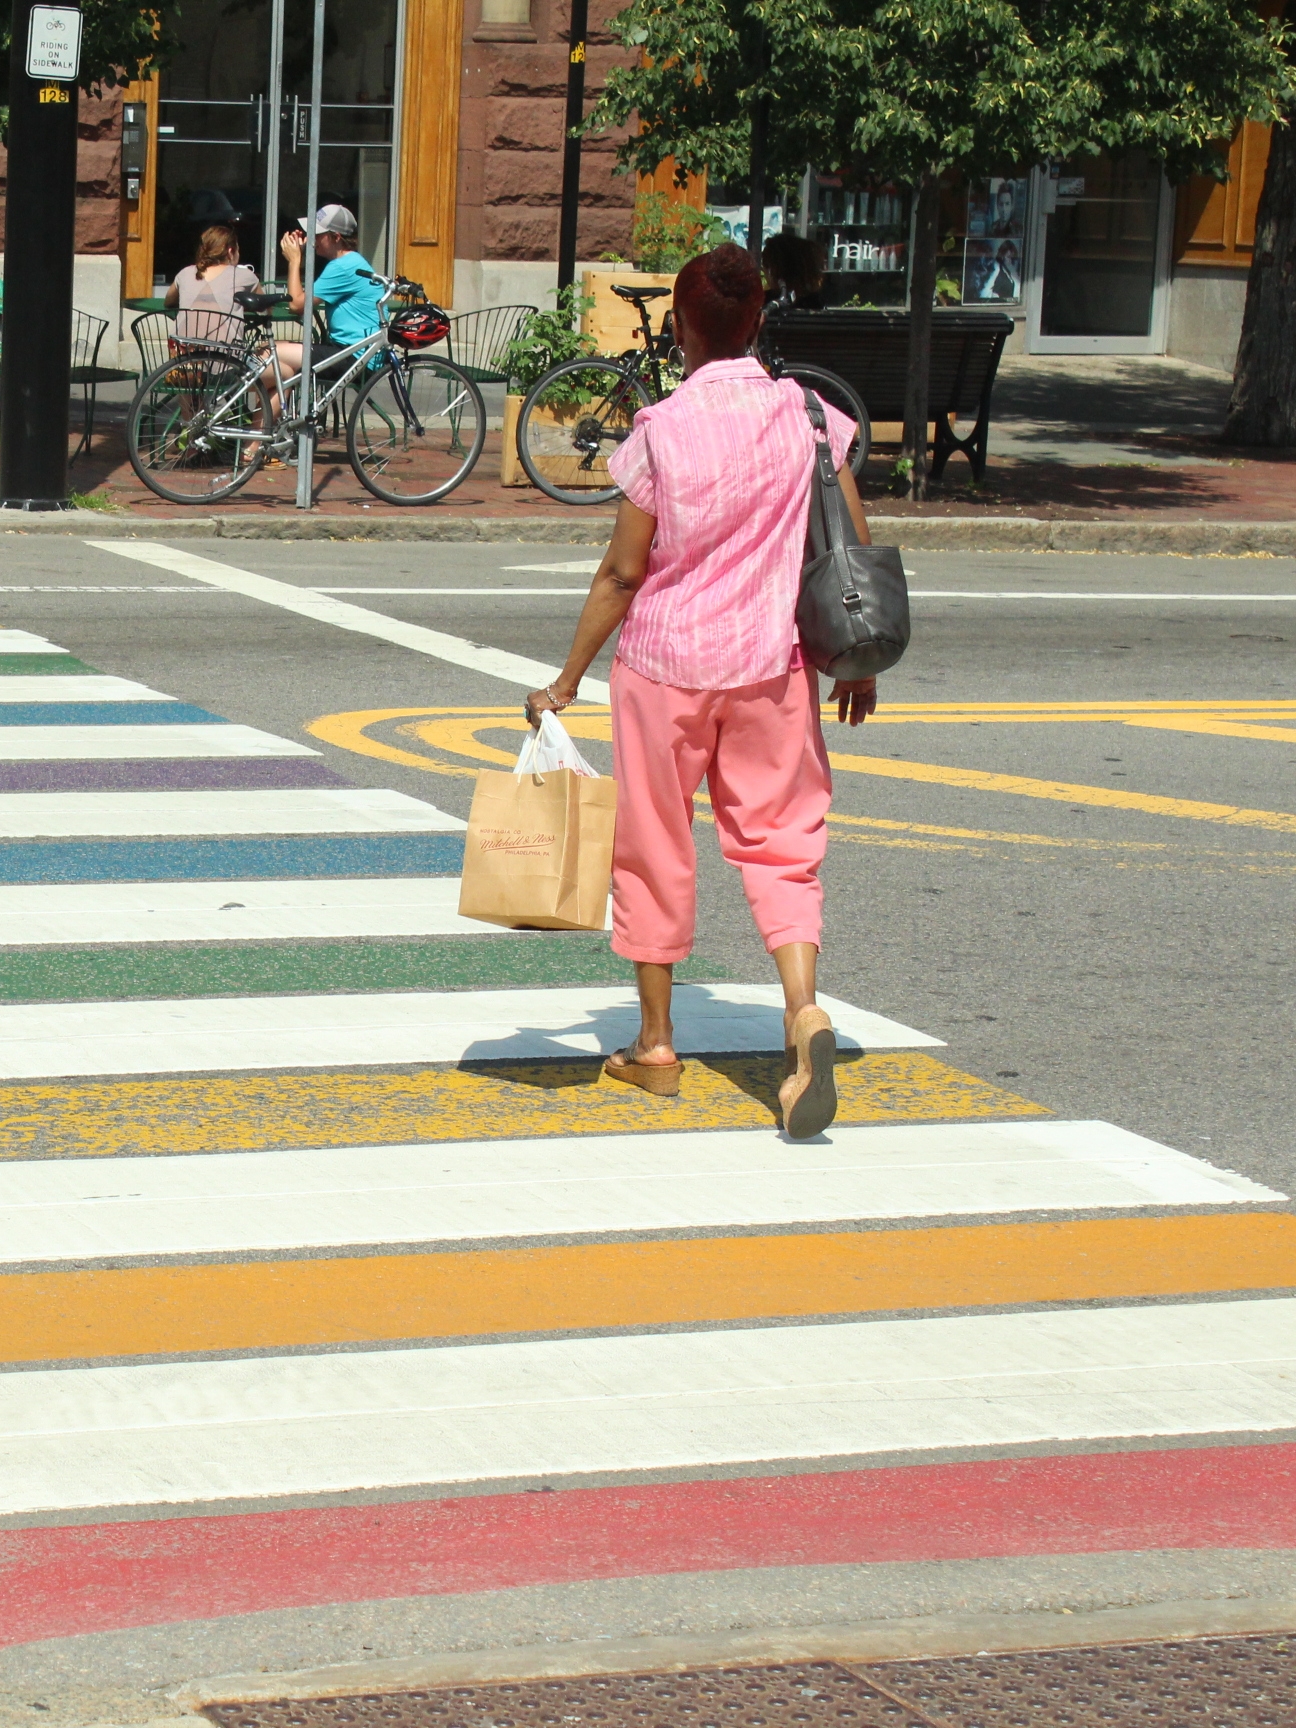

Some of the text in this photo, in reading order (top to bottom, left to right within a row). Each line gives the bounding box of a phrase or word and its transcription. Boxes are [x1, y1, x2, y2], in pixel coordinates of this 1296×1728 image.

[40, 41, 68, 50] RIDING
[32, 59, 73, 69] SIDEWALK
[41, 89, 67, 102] 128
[833, 233, 879, 260] hair
[480, 833, 556, 849] Mitchell & Ness
